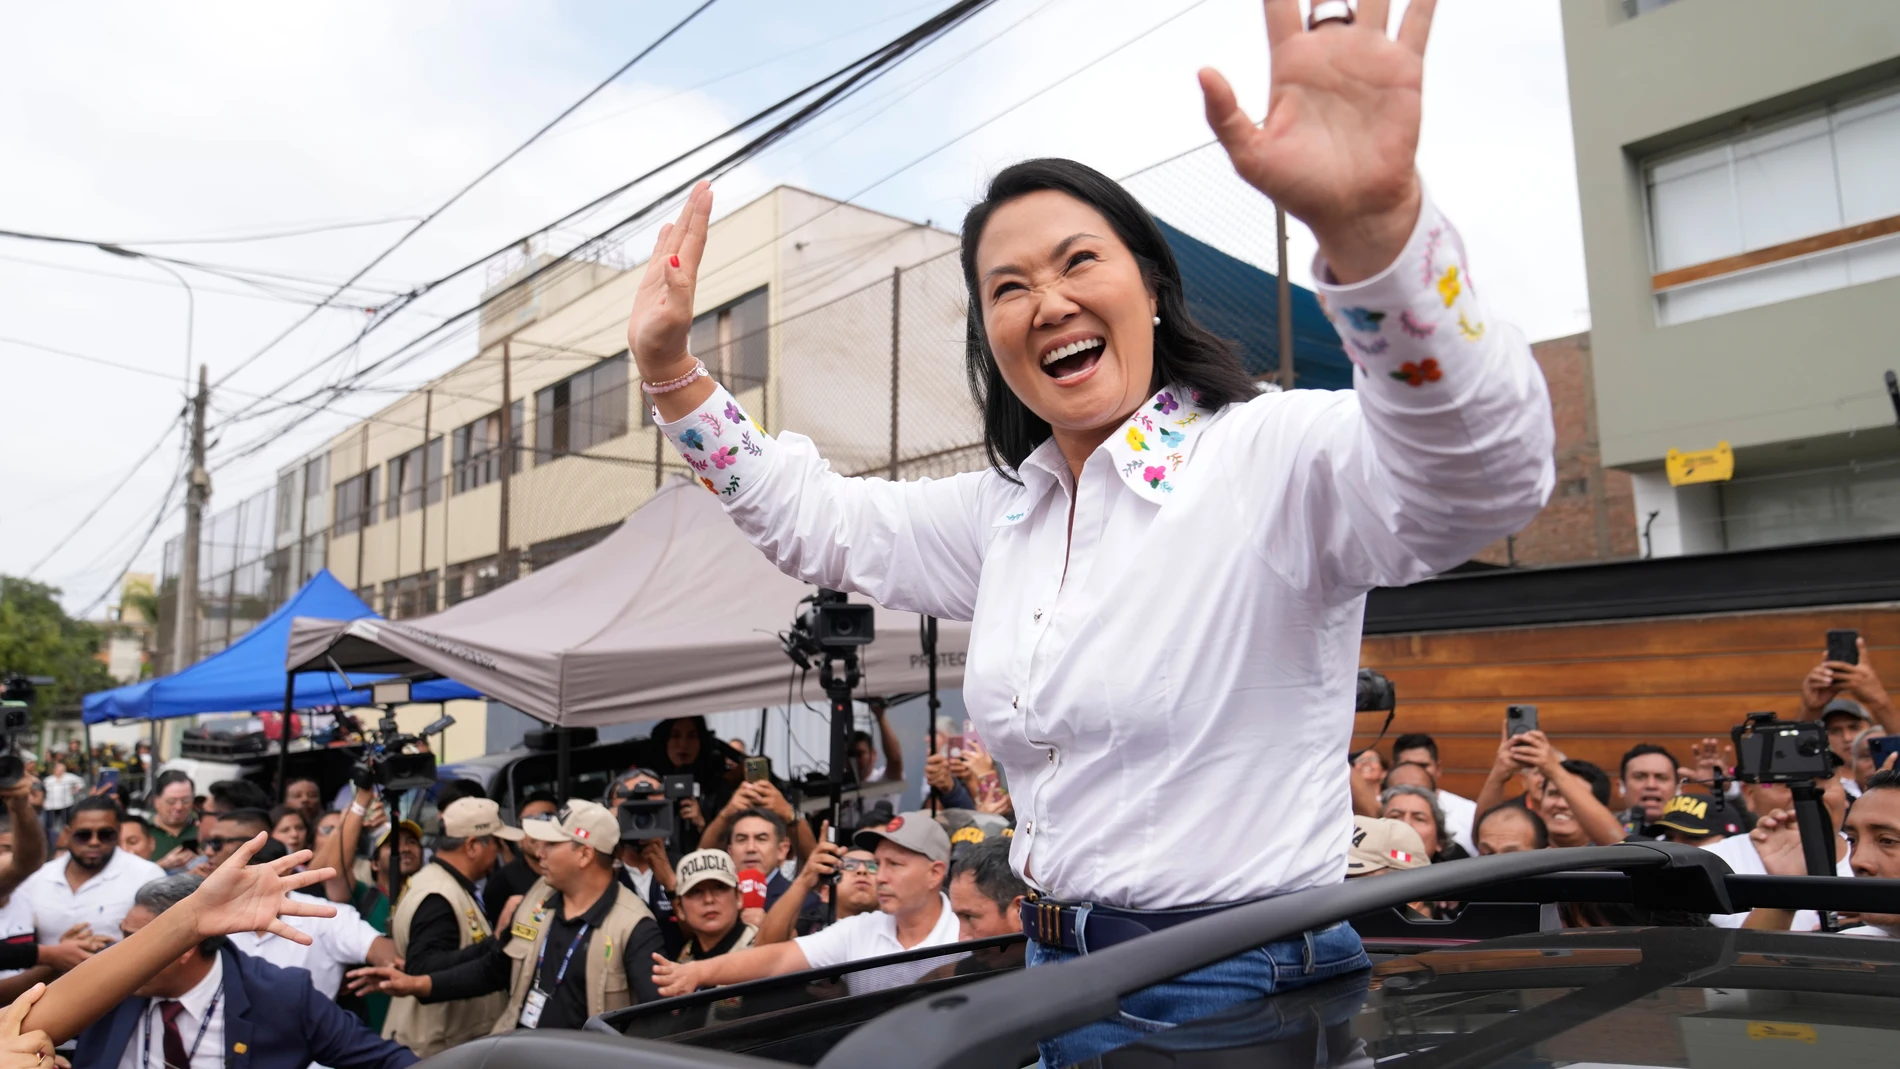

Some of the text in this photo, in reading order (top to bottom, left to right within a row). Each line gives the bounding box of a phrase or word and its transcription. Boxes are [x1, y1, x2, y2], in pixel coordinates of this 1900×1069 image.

[909, 651, 967, 669] PRTEC
[1663, 796, 1708, 819] OLICIA
[681, 855, 729, 881] POLICIA
